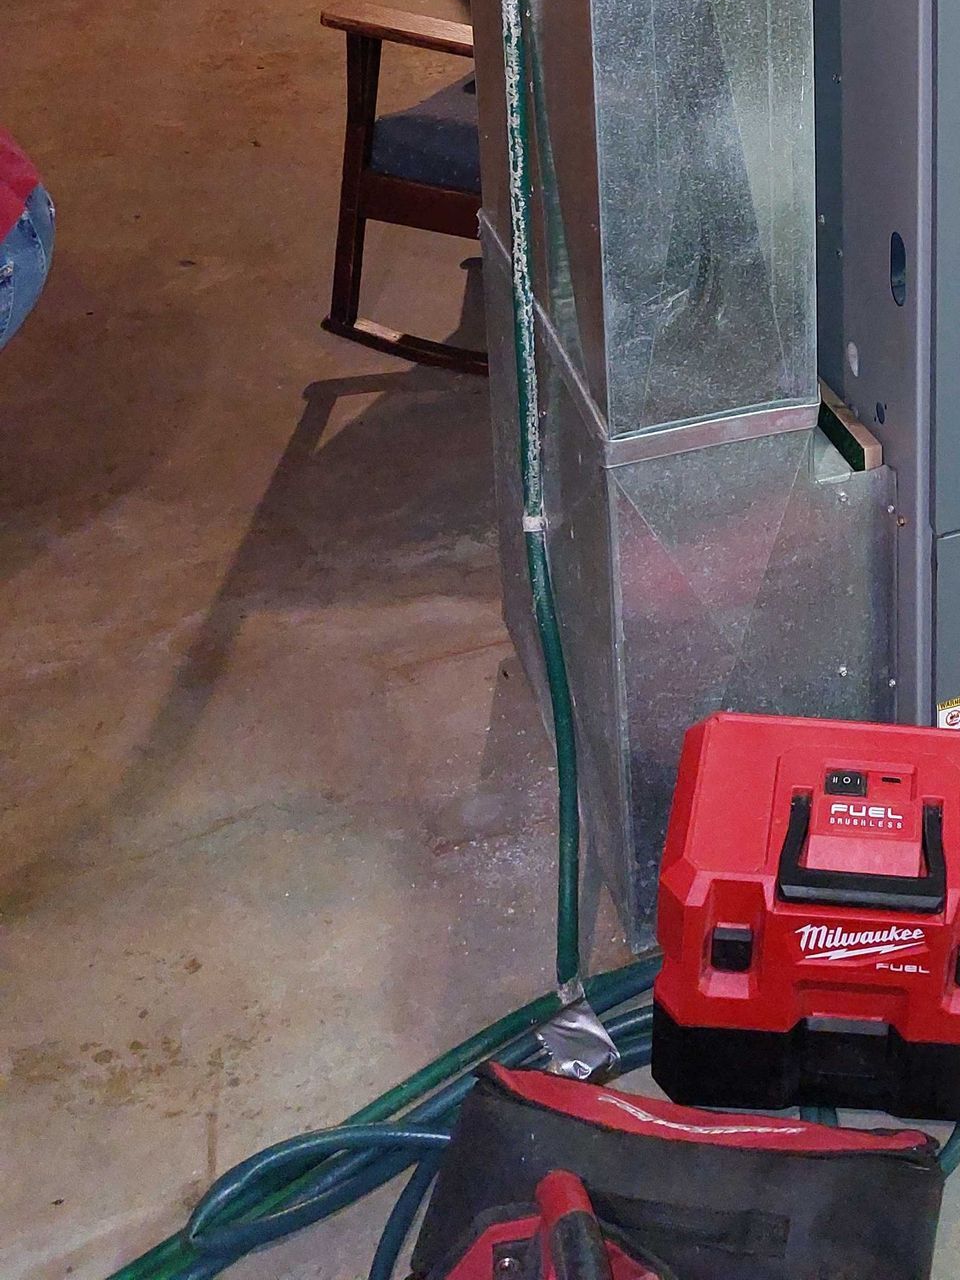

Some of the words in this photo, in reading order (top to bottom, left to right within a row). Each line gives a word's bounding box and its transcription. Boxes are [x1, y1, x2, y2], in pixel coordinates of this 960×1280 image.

[830, 803, 904, 820] FUEL
[829, 816, 904, 830] BRUSHLESS
[794, 923, 926, 954] Milwaukee
[875, 962, 931, 974] FUEL
